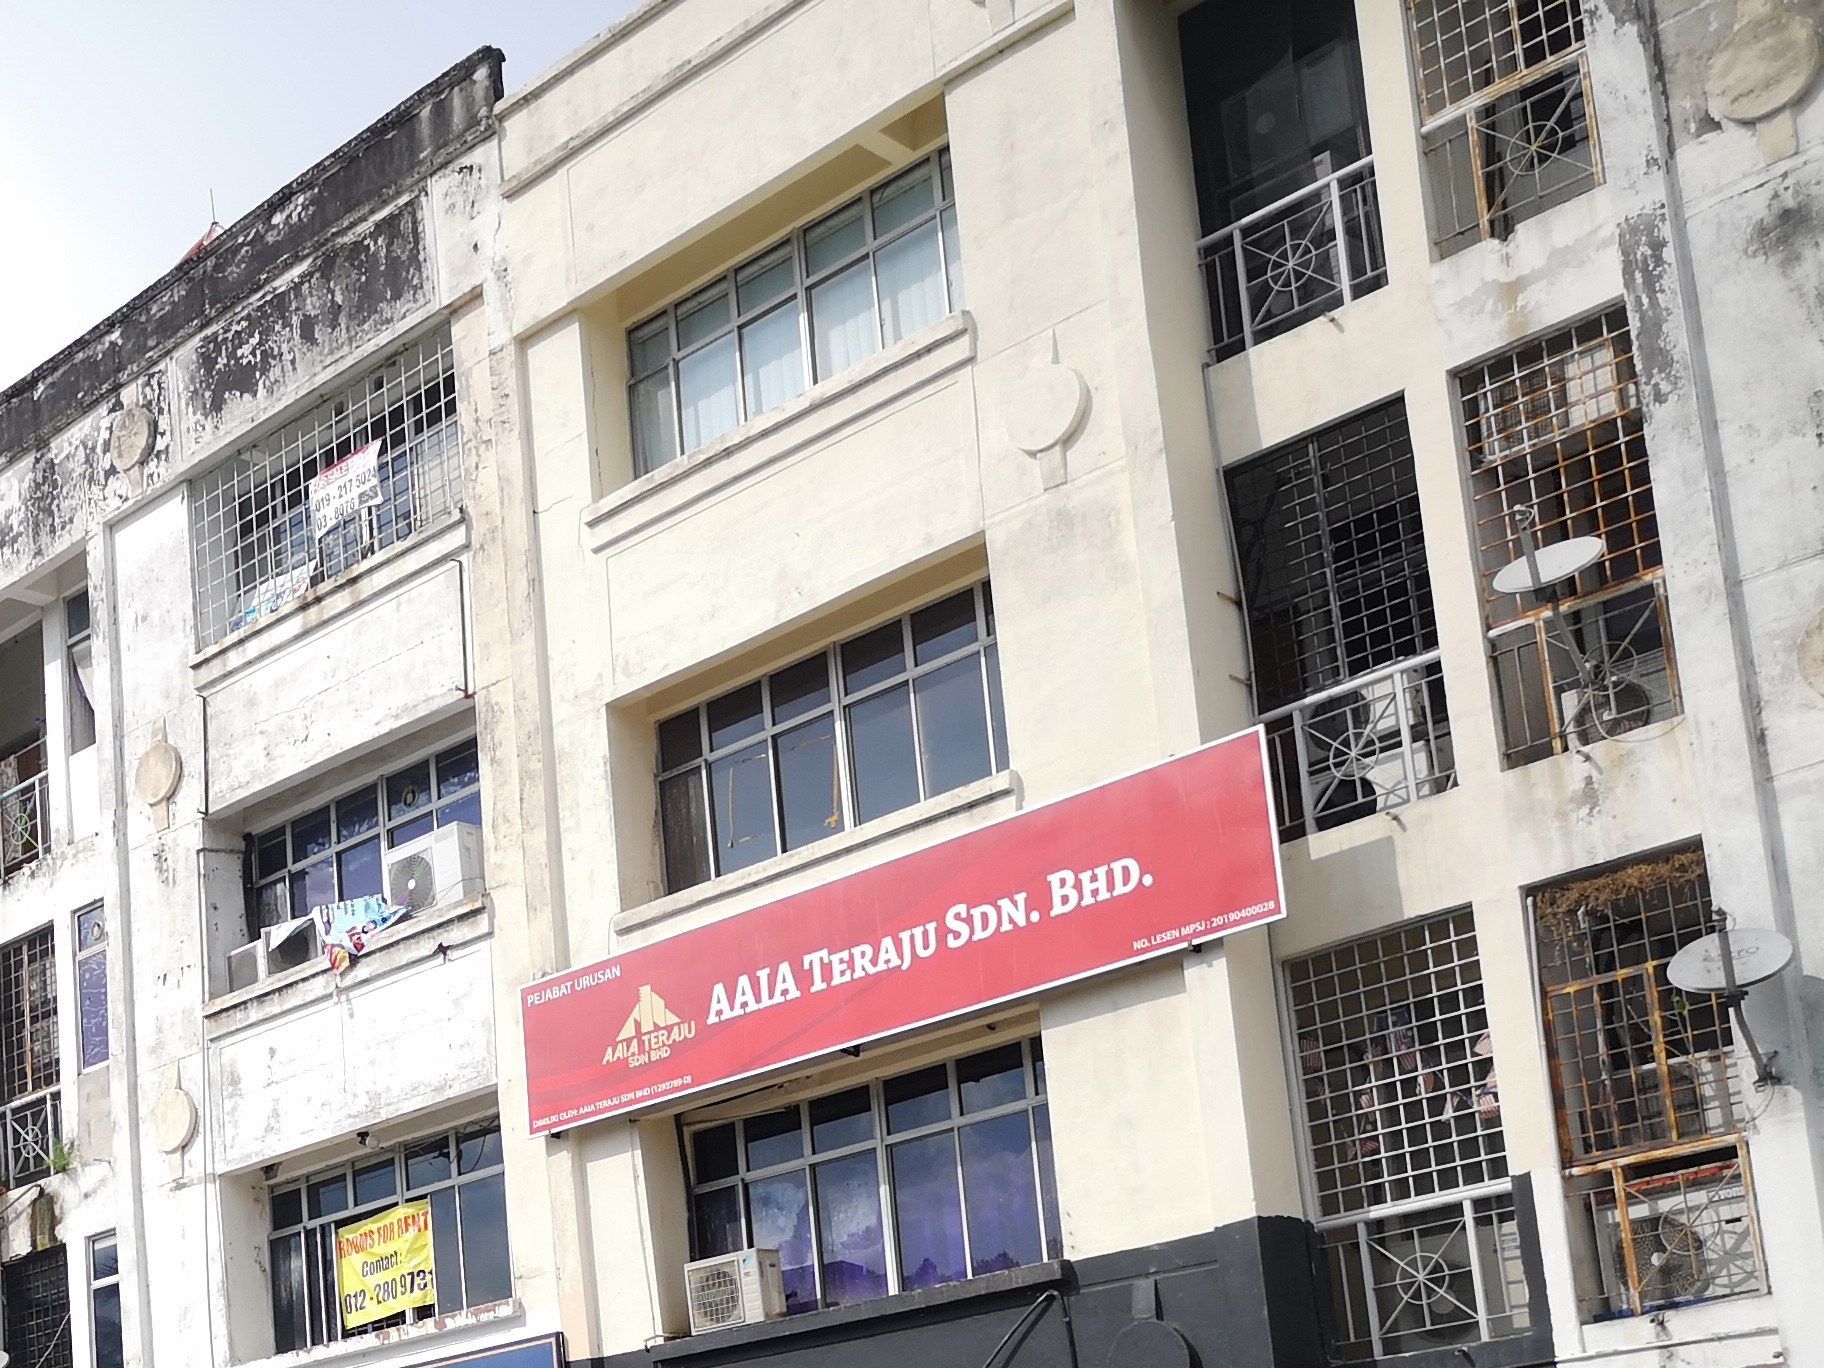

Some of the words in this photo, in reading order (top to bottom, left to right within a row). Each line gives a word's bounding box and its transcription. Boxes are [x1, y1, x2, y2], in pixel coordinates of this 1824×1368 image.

[1133, 939, 1150, 950] NO.
[1151, 930, 1180, 945] LESEN
[1181, 920, 1206, 937] MPSJ
[527, 980, 573, 1008] PEJABAT
[575, 964, 621, 991] URUSAN
[706, 963, 801, 1026] AAIA
[804, 920, 939, 995] TERAJU
[602, 1039, 639, 1066] AAIA
[641, 1020, 696, 1050] TERAJU
[628, 1053, 649, 1068] SDN
[650, 1045, 671, 1062] BHD
[377, 1222, 396, 1246] FOR
[397, 1209, 429, 1239] RENT
[344, 1289, 367, 1315] 012
